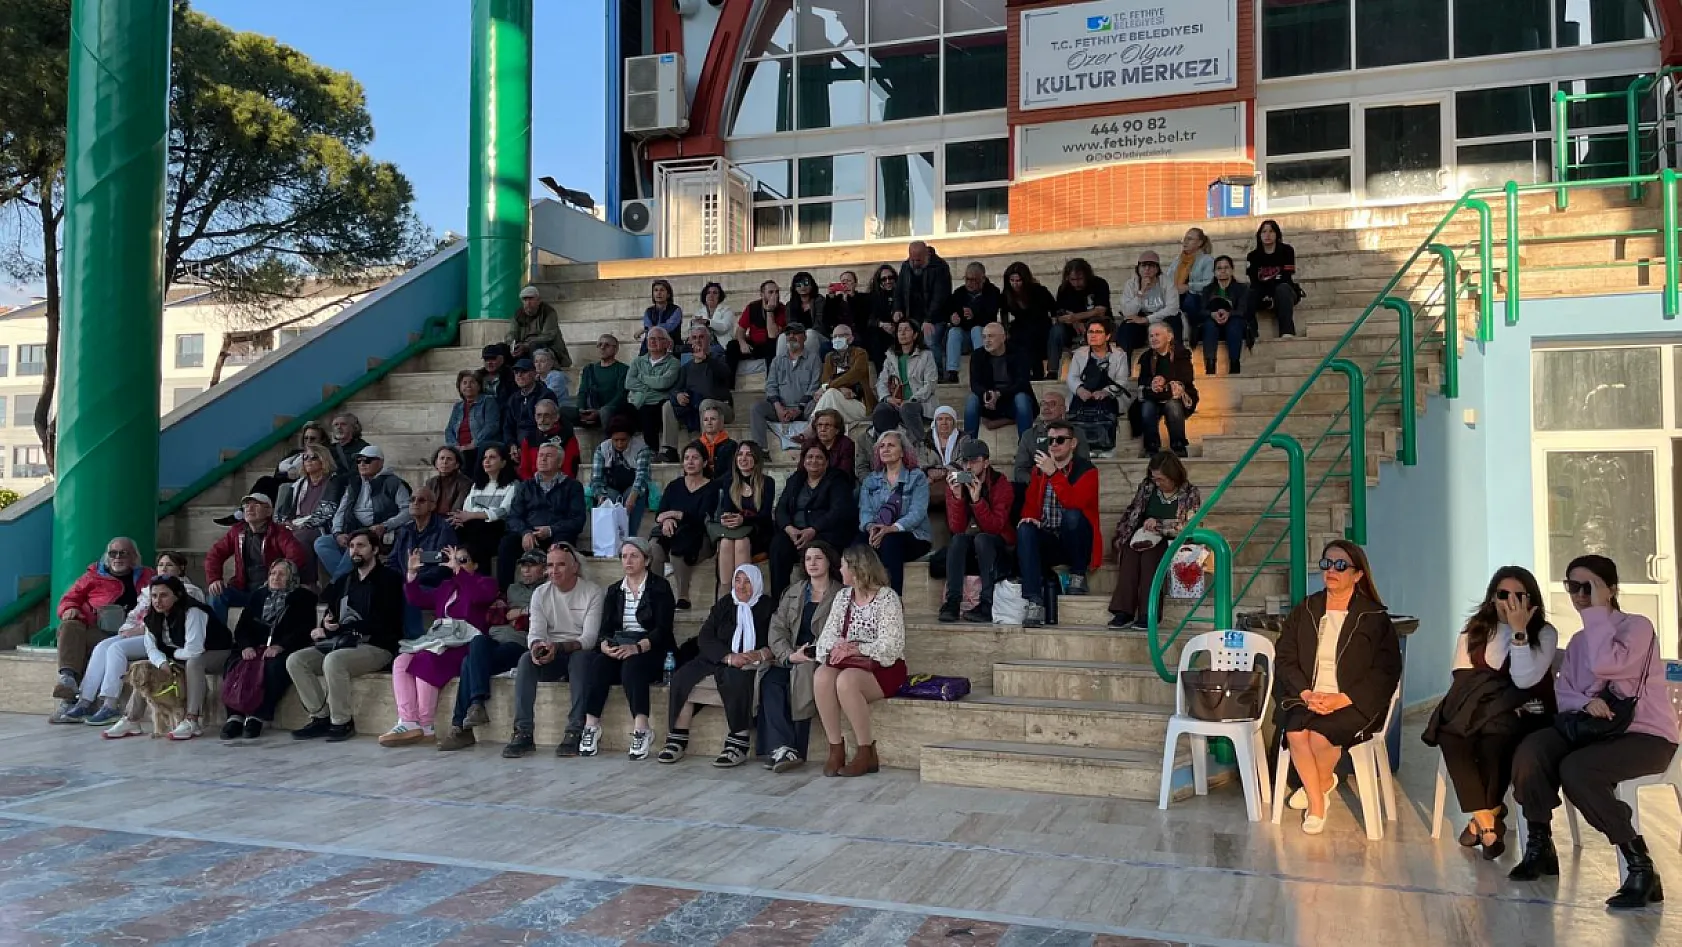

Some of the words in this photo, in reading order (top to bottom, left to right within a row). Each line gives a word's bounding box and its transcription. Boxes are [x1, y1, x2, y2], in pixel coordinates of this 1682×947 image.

[1051, 40, 1073, 51] T.C.
[1120, 43, 1186, 66] Olgun
[1090, 122, 1120, 137] 444
[1122, 118, 1143, 133] 90
[1147, 116, 1168, 130] 82
[1062, 129, 1197, 154] www.fethiye.bel.tr
